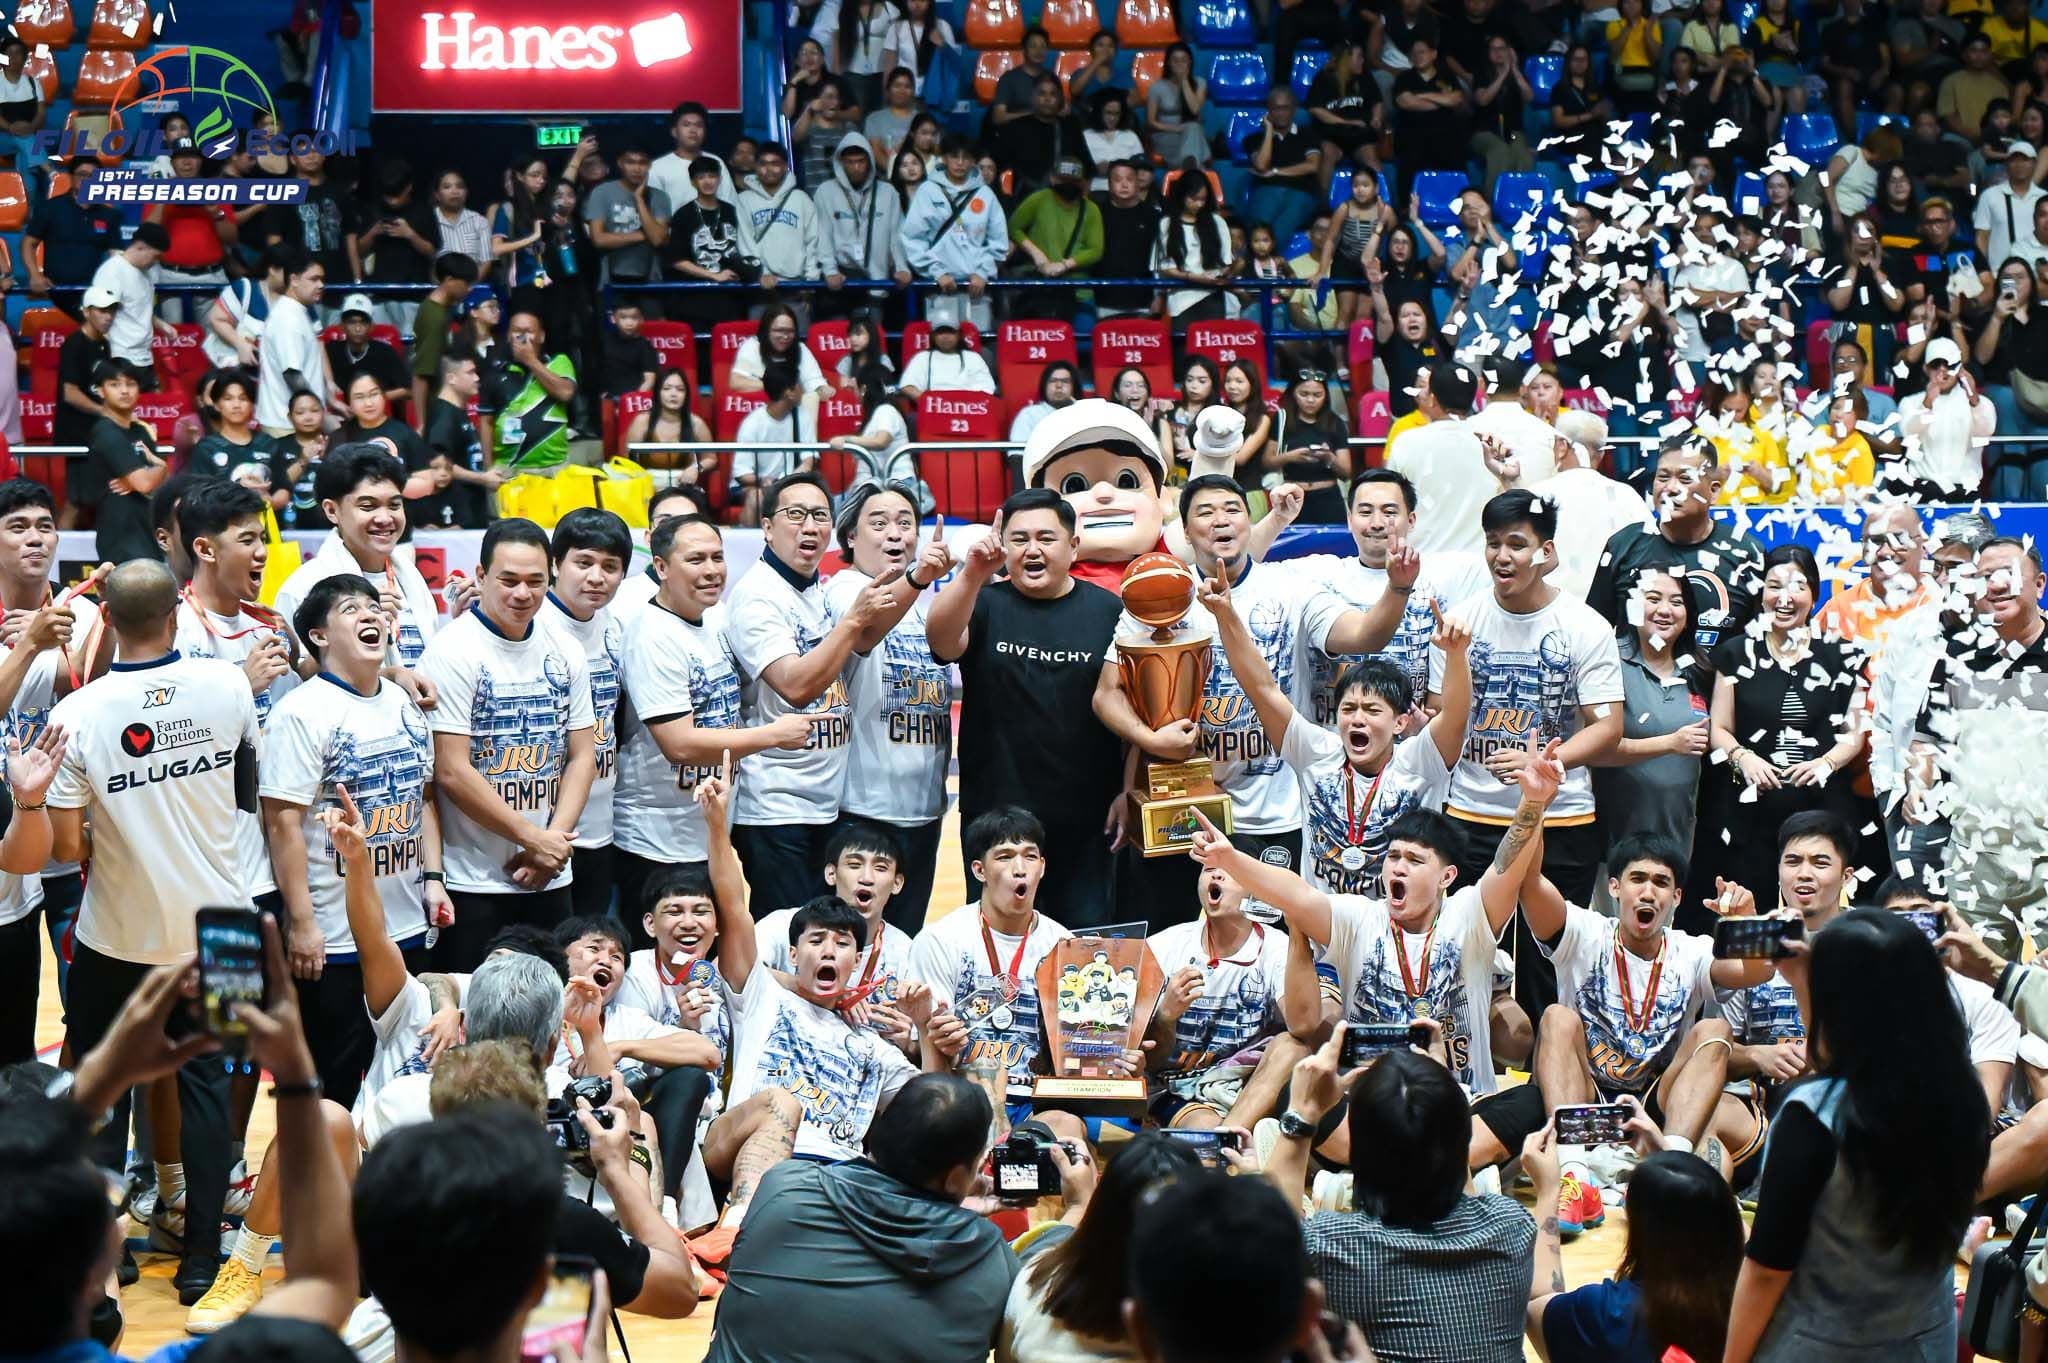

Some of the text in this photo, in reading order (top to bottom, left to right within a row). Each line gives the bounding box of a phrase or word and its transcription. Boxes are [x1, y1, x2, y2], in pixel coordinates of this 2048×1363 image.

[419, 12, 618, 70] Hanes
[541, 127, 583, 145] EXIT
[1006, 325, 1066, 343] Hanes
[1101, 331, 1161, 348] Hanes
[1195, 331, 1257, 347] Hanes
[1029, 346, 1046, 359] 24
[1125, 351, 1142, 363] 25
[1220, 349, 1236, 362] 26
[134, 403, 179, 418] anes
[926, 396, 988, 416] Hanes
[951, 419, 969, 433] 23
[996, 641, 1092, 663] GIVENCHY
[906, 679, 946, 707] JRU
[1199, 695, 1245, 726] RU
[155, 716, 193, 735] Farm
[1473, 708, 1537, 735] JRU
[156, 726, 212, 750] Options
[487, 743, 551, 776] JRU
[107, 749, 232, 794] BLUGAS
[365, 798, 417, 840] JRU
[966, 1039, 1030, 1068] JRU
[1589, 1041, 1647, 1082] JRU
